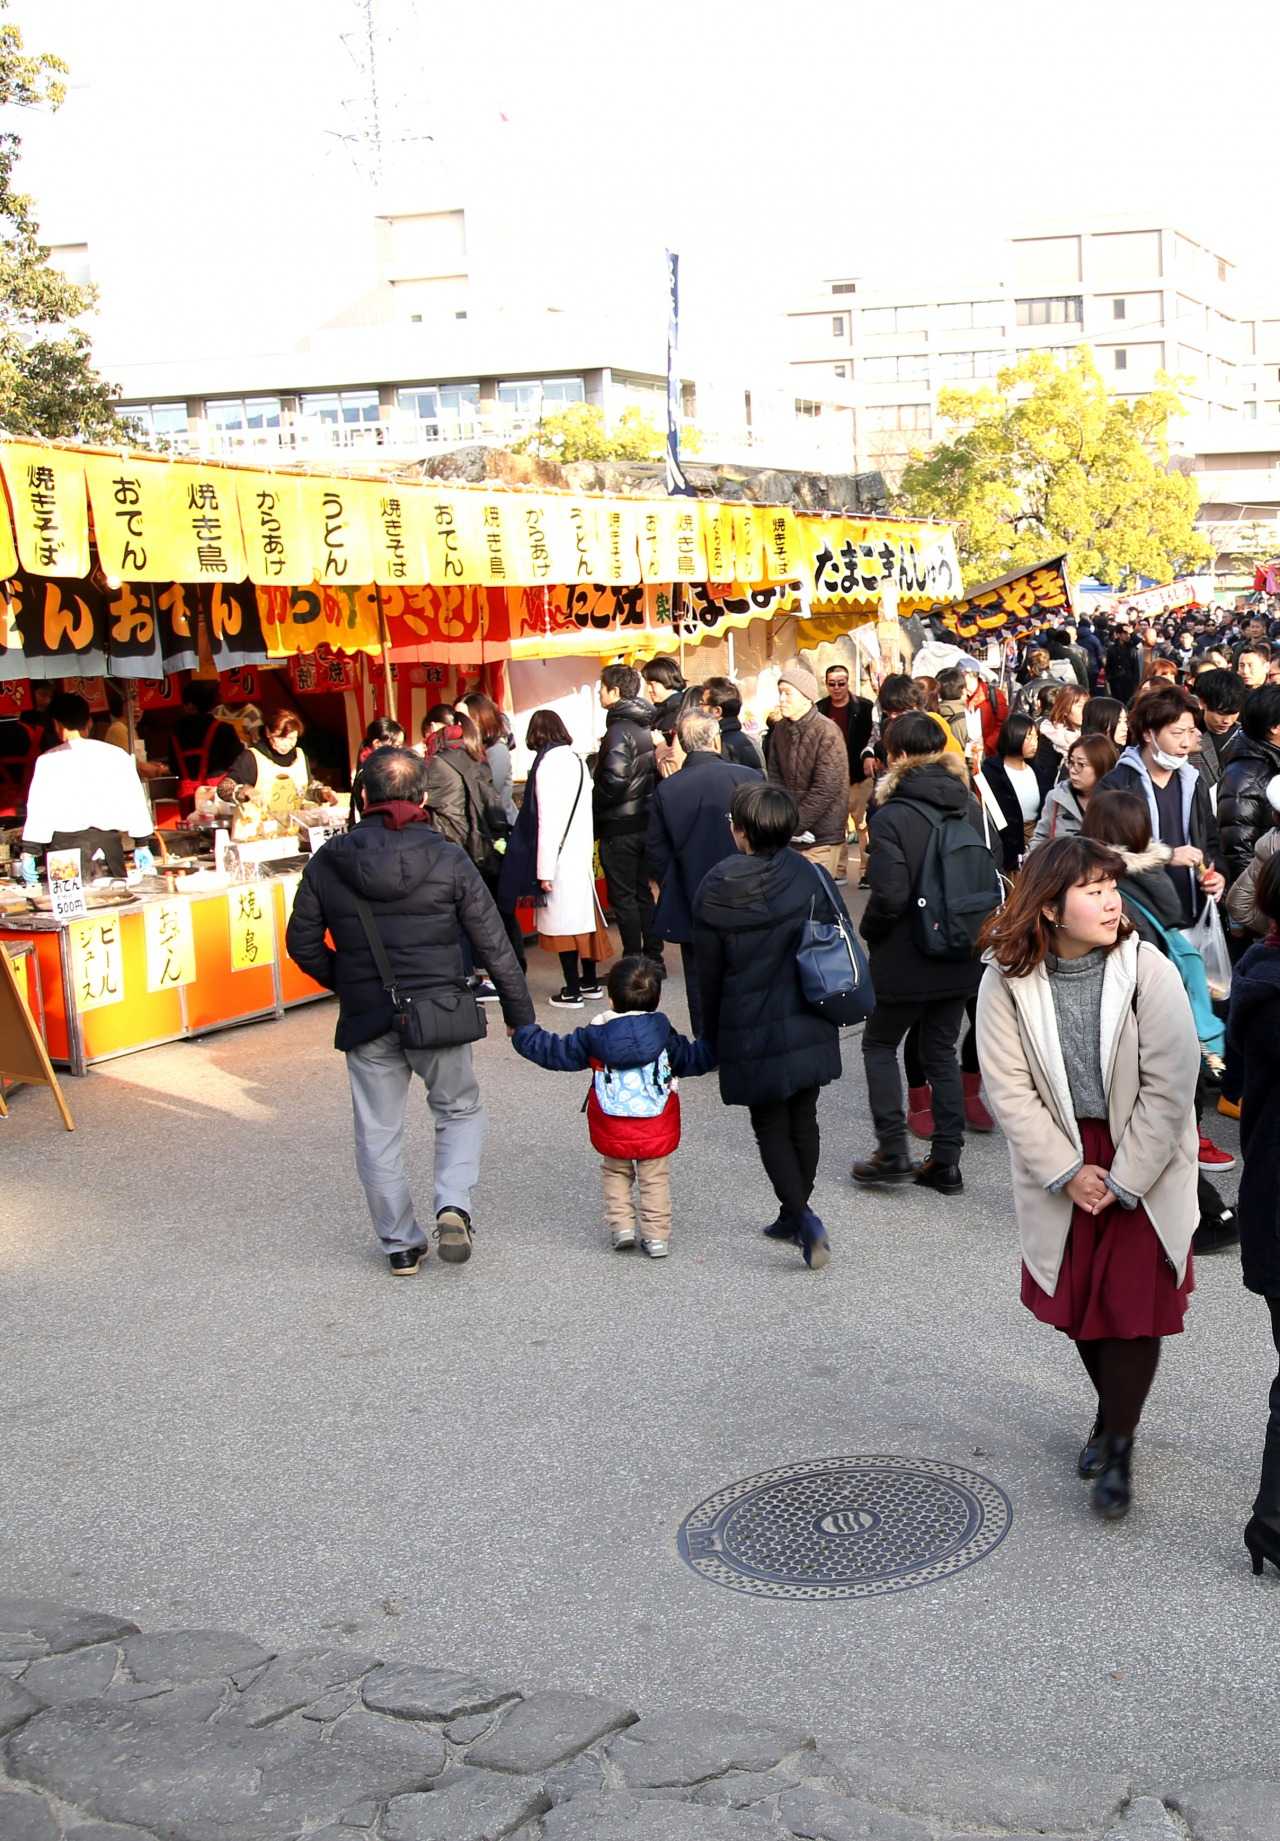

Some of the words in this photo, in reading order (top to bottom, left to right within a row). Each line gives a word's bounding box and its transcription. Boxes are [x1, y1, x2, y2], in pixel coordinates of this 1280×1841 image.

[112, 477, 147, 571] おでん
[188, 483, 228, 573] 焼き鳥
[53, 880, 80, 894] おでん
[57, 900, 83, 914] 500円
[80, 927, 95, 1001] ジュース
[100, 920, 117, 997] ビール
